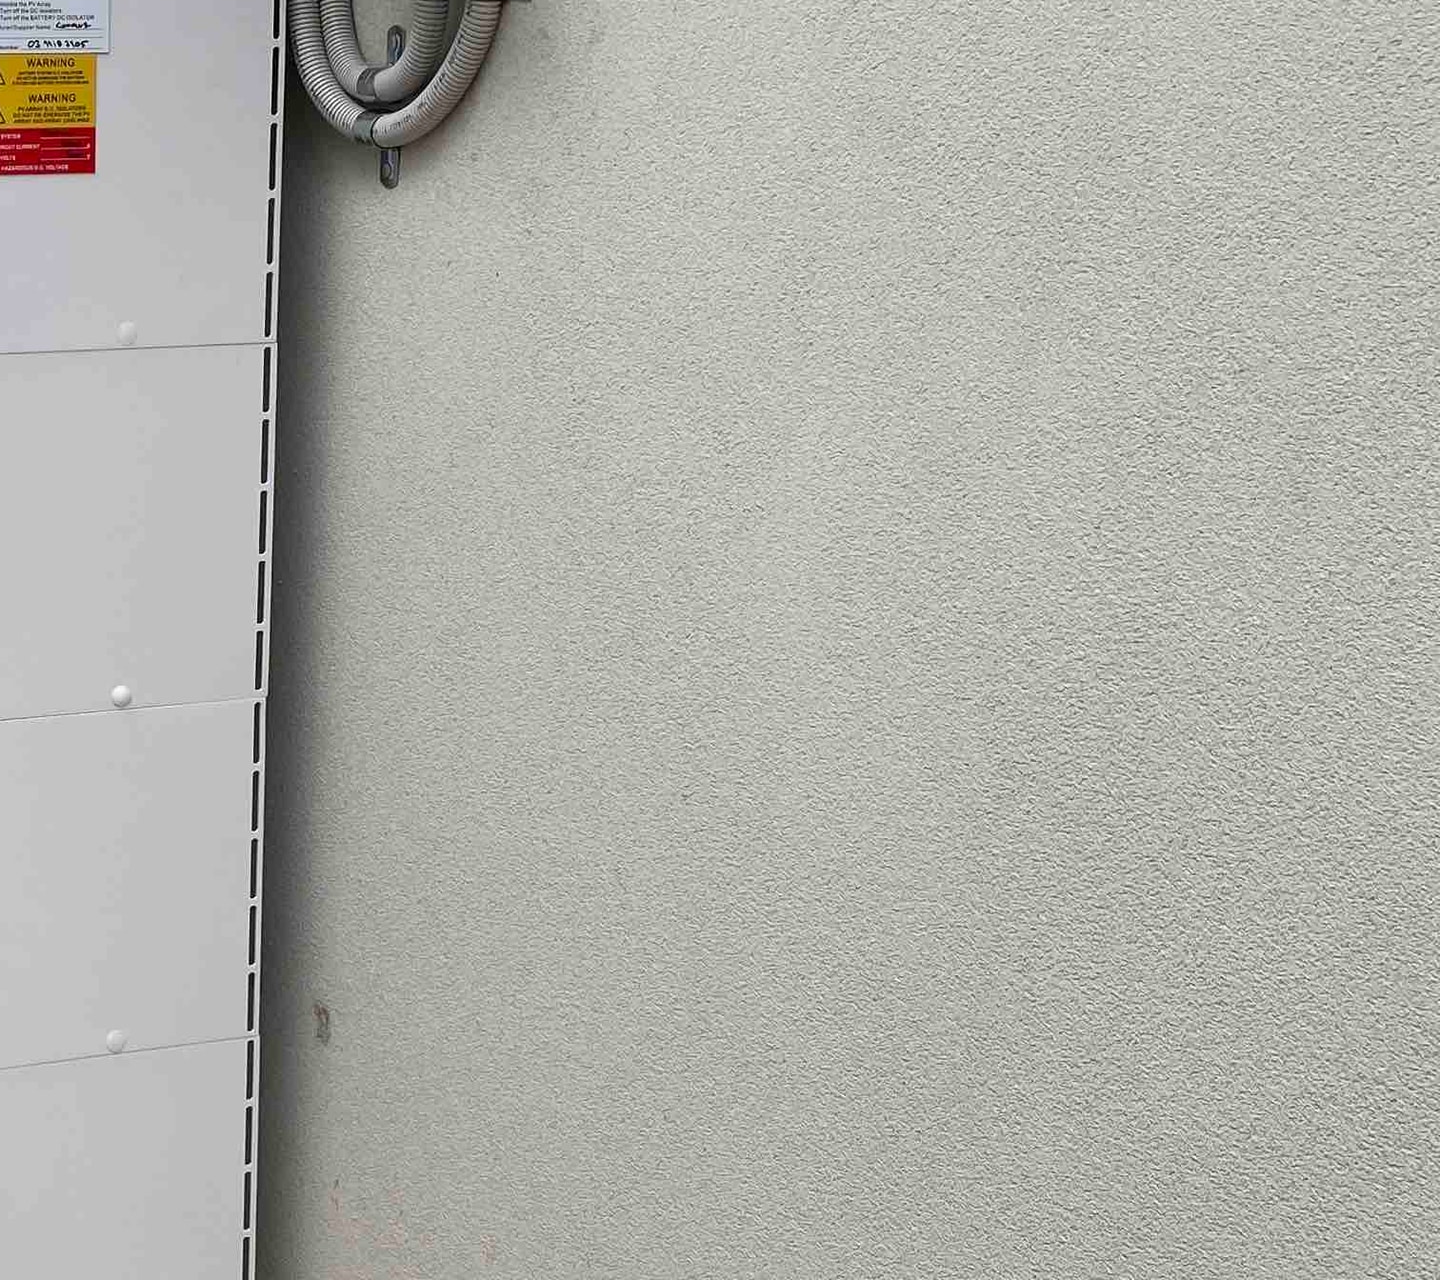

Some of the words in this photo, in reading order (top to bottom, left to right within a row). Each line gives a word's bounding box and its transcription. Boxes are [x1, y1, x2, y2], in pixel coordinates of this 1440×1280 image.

[27, 39, 41, 49] 03
[26, 58, 76, 68] WARNING
[28, 93, 77, 103] WARNING
